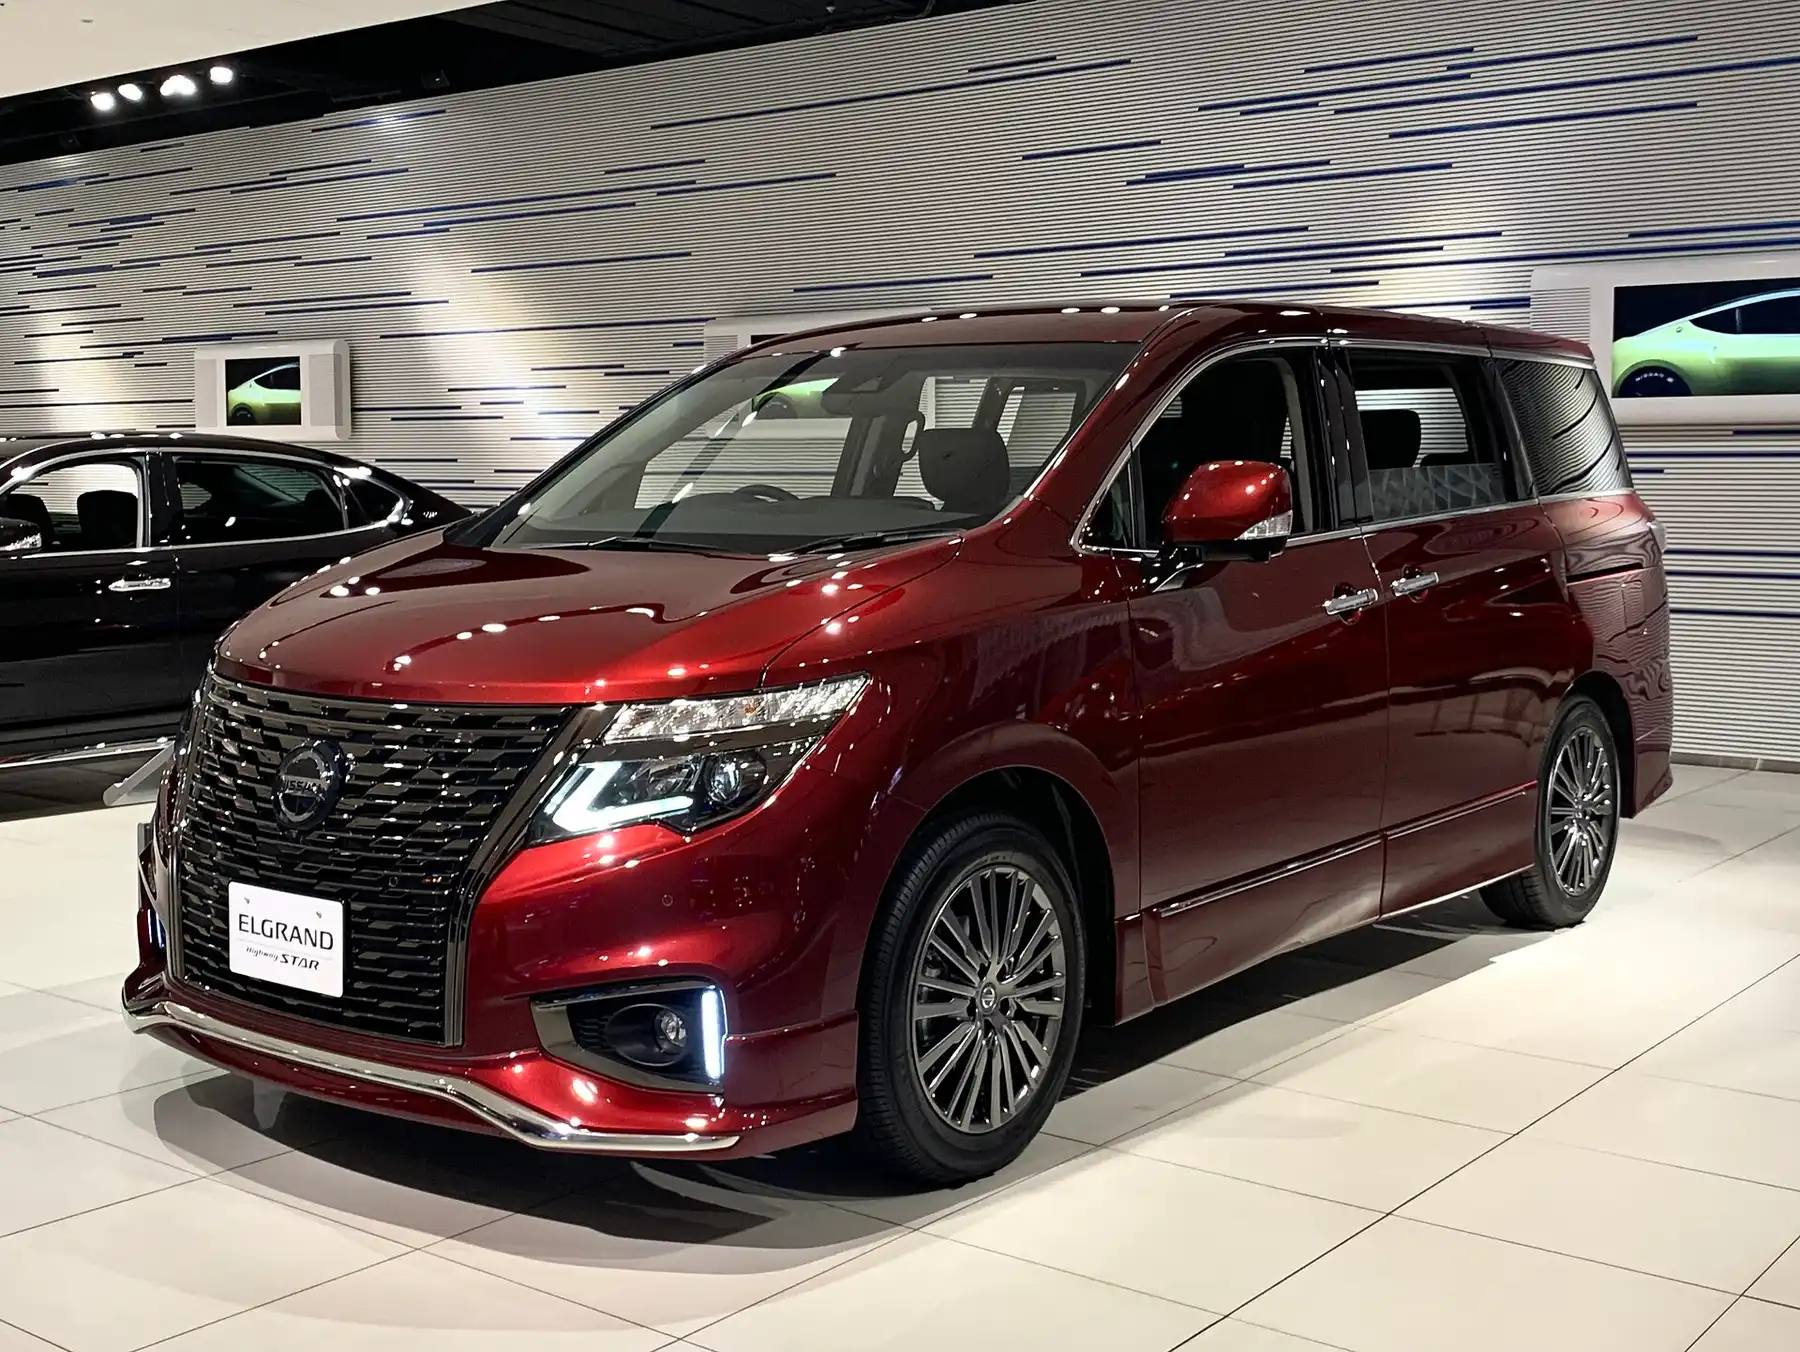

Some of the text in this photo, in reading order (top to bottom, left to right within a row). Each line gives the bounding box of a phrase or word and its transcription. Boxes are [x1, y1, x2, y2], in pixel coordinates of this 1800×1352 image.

[239, 913, 334, 951] ELGRAND
[246, 946, 319, 971] Highway STAR
